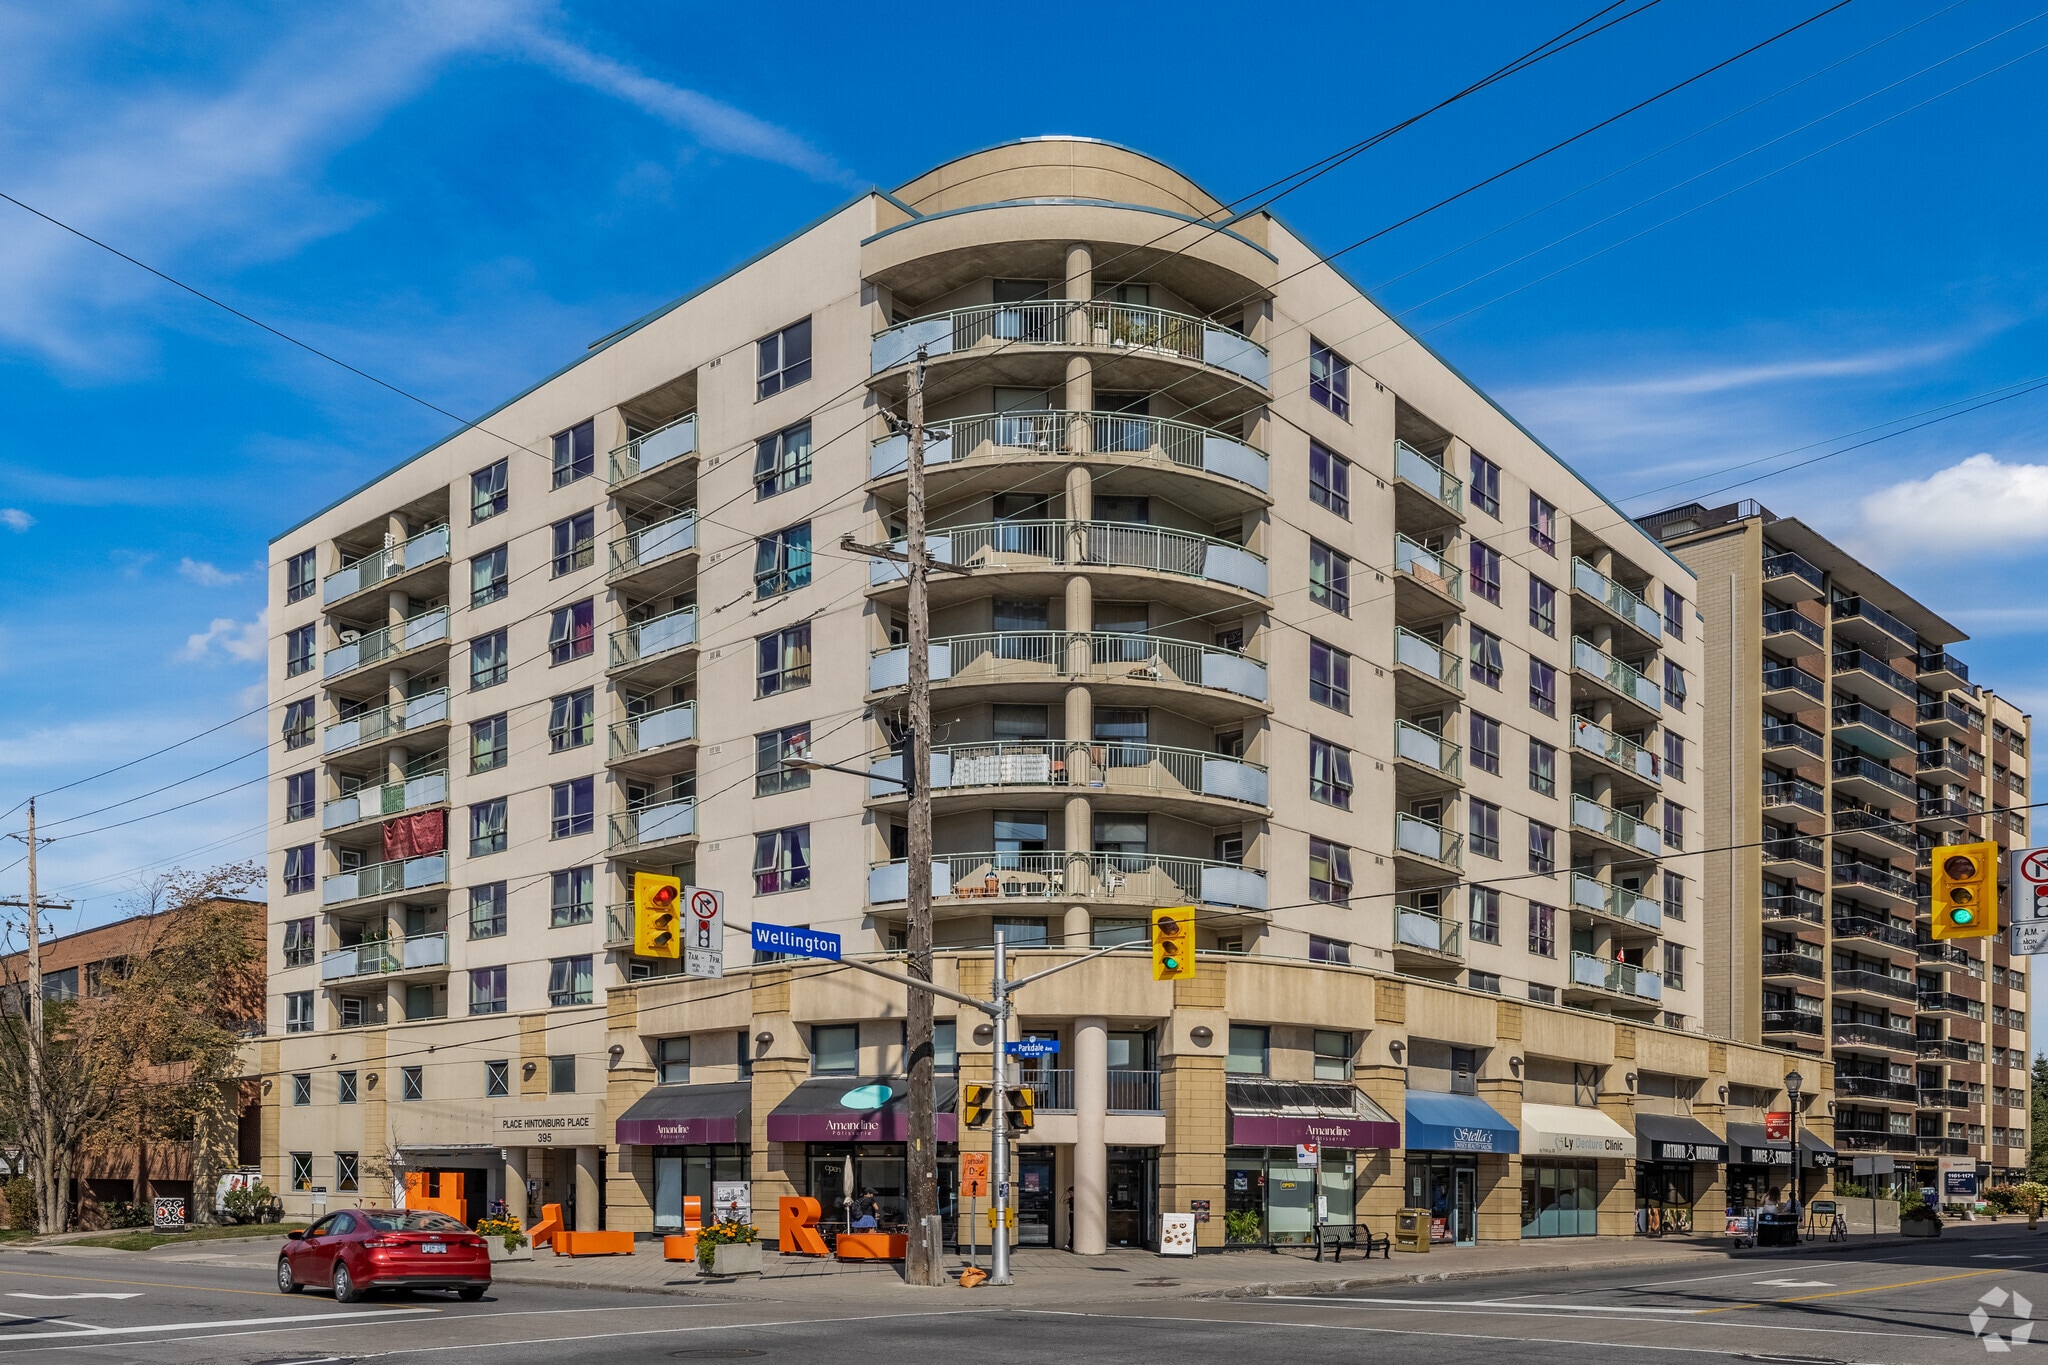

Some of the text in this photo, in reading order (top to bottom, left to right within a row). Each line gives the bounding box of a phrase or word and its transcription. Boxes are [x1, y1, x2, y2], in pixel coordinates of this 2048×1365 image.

[2015, 927, 2021, 937] 7
[756, 928, 837, 953] Wellington
[1018, 1043, 1044, 1052] Parkdale
[502, 1117, 589, 1129] PLACE HINTONBURG PLACE
[656, 1124, 690, 1134] Amandine
[825, 1119, 879, 1130] Amandine
[1305, 1124, 1351, 1136] Amandine
[1453, 1127, 1493, 1143] Stella's
[537, 1133, 552, 1143] 395
[1564, 1136, 1574, 1151] Ly
[1575, 1137, 1603, 1150] Denture
[1604, 1139, 1623, 1151] Clinic
[1662, 1143, 1719, 1161] ARTHUR MURRAY
[1752, 1149, 1768, 1163] DANCE
[779, 1196, 830, 1254] R
